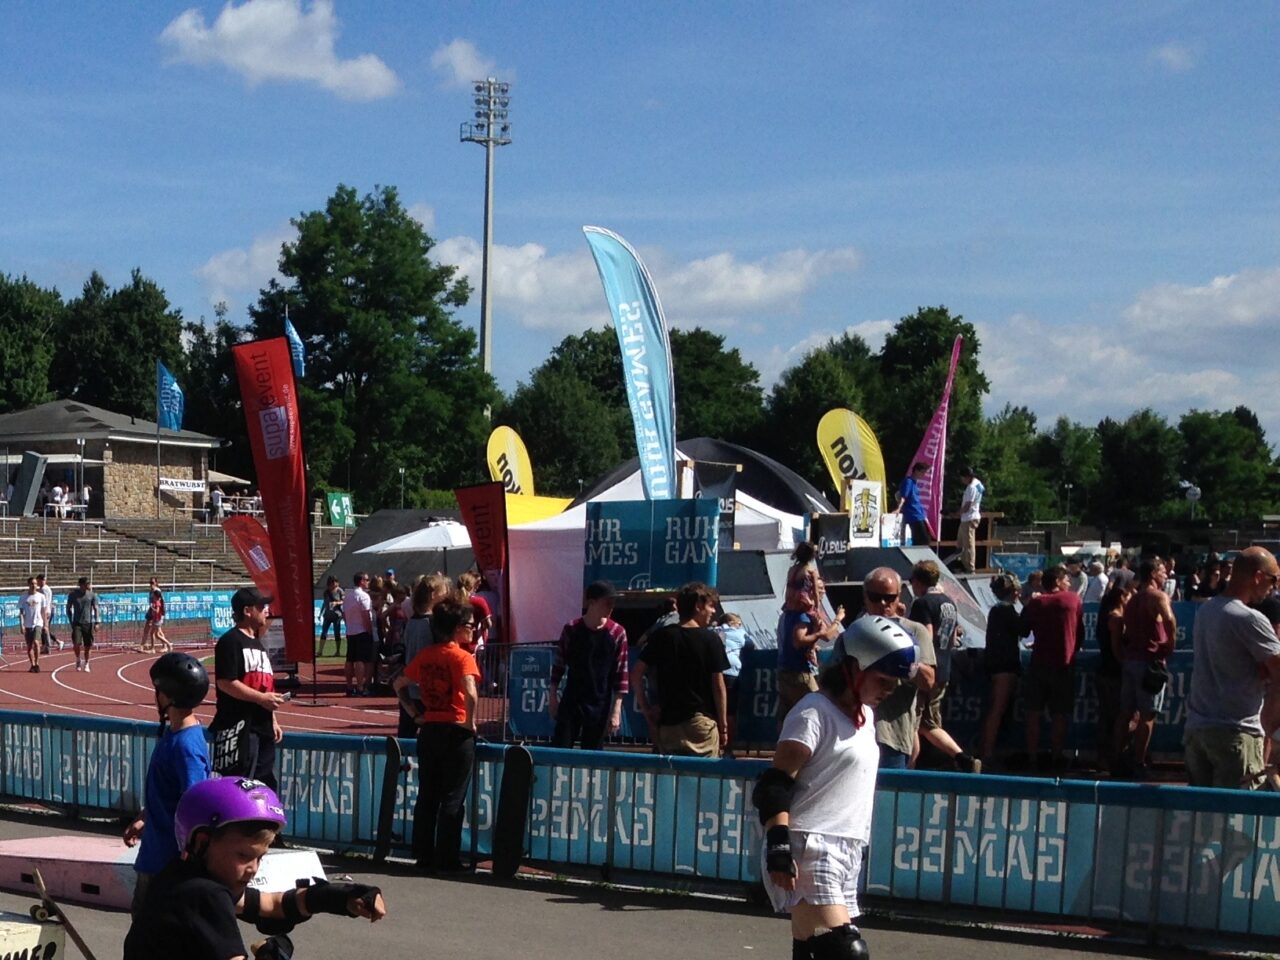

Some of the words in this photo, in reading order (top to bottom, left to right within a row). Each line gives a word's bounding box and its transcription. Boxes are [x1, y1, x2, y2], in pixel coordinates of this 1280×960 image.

[160, 479, 205, 488] BRATWURST
[665, 516, 718, 539] RUH
[665, 541, 718, 564] GAM
